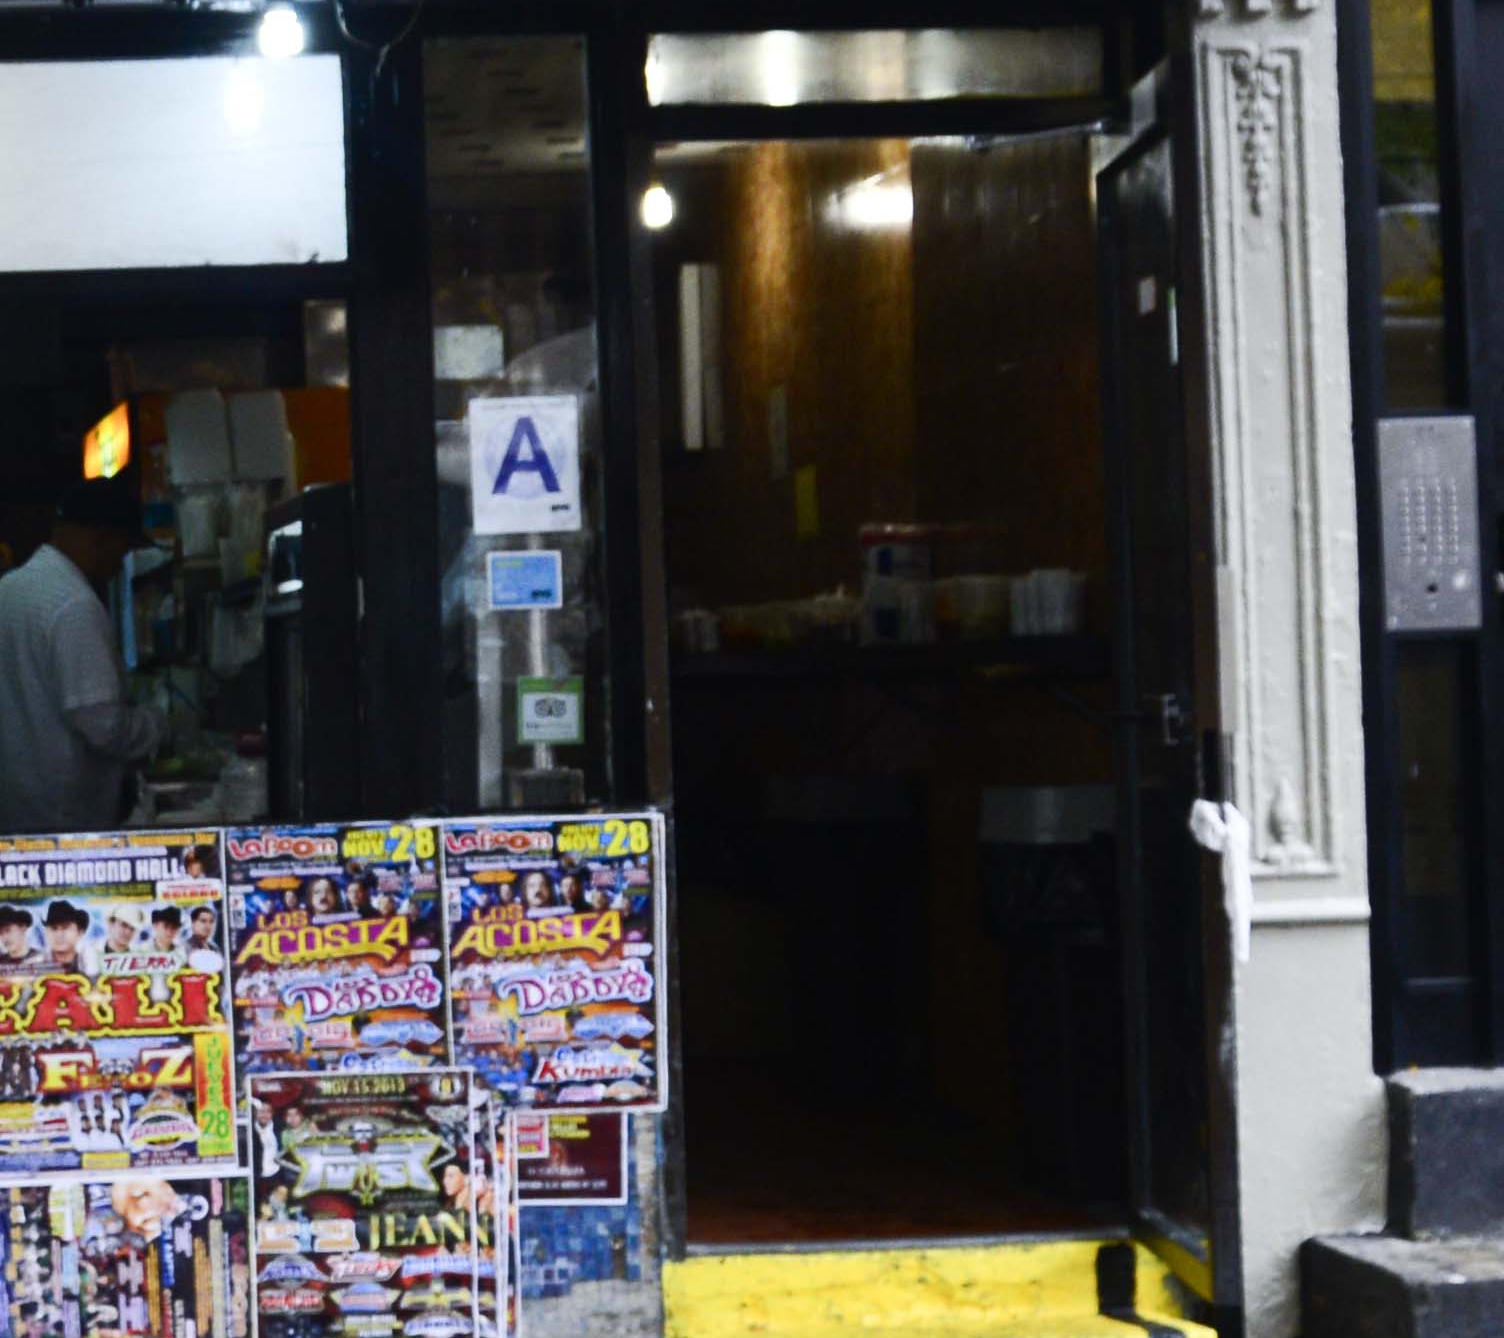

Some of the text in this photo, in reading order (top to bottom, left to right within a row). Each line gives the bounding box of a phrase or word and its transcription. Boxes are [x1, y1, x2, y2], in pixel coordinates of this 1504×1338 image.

[491, 416, 561, 495] A
[389, 825, 435, 862] 28
[603, 819, 649, 857] 28
[45, 860, 132, 884] DIAMOND
[235, 915, 410, 965] ACOSTA
[451, 911, 622, 957] ACOSTA
